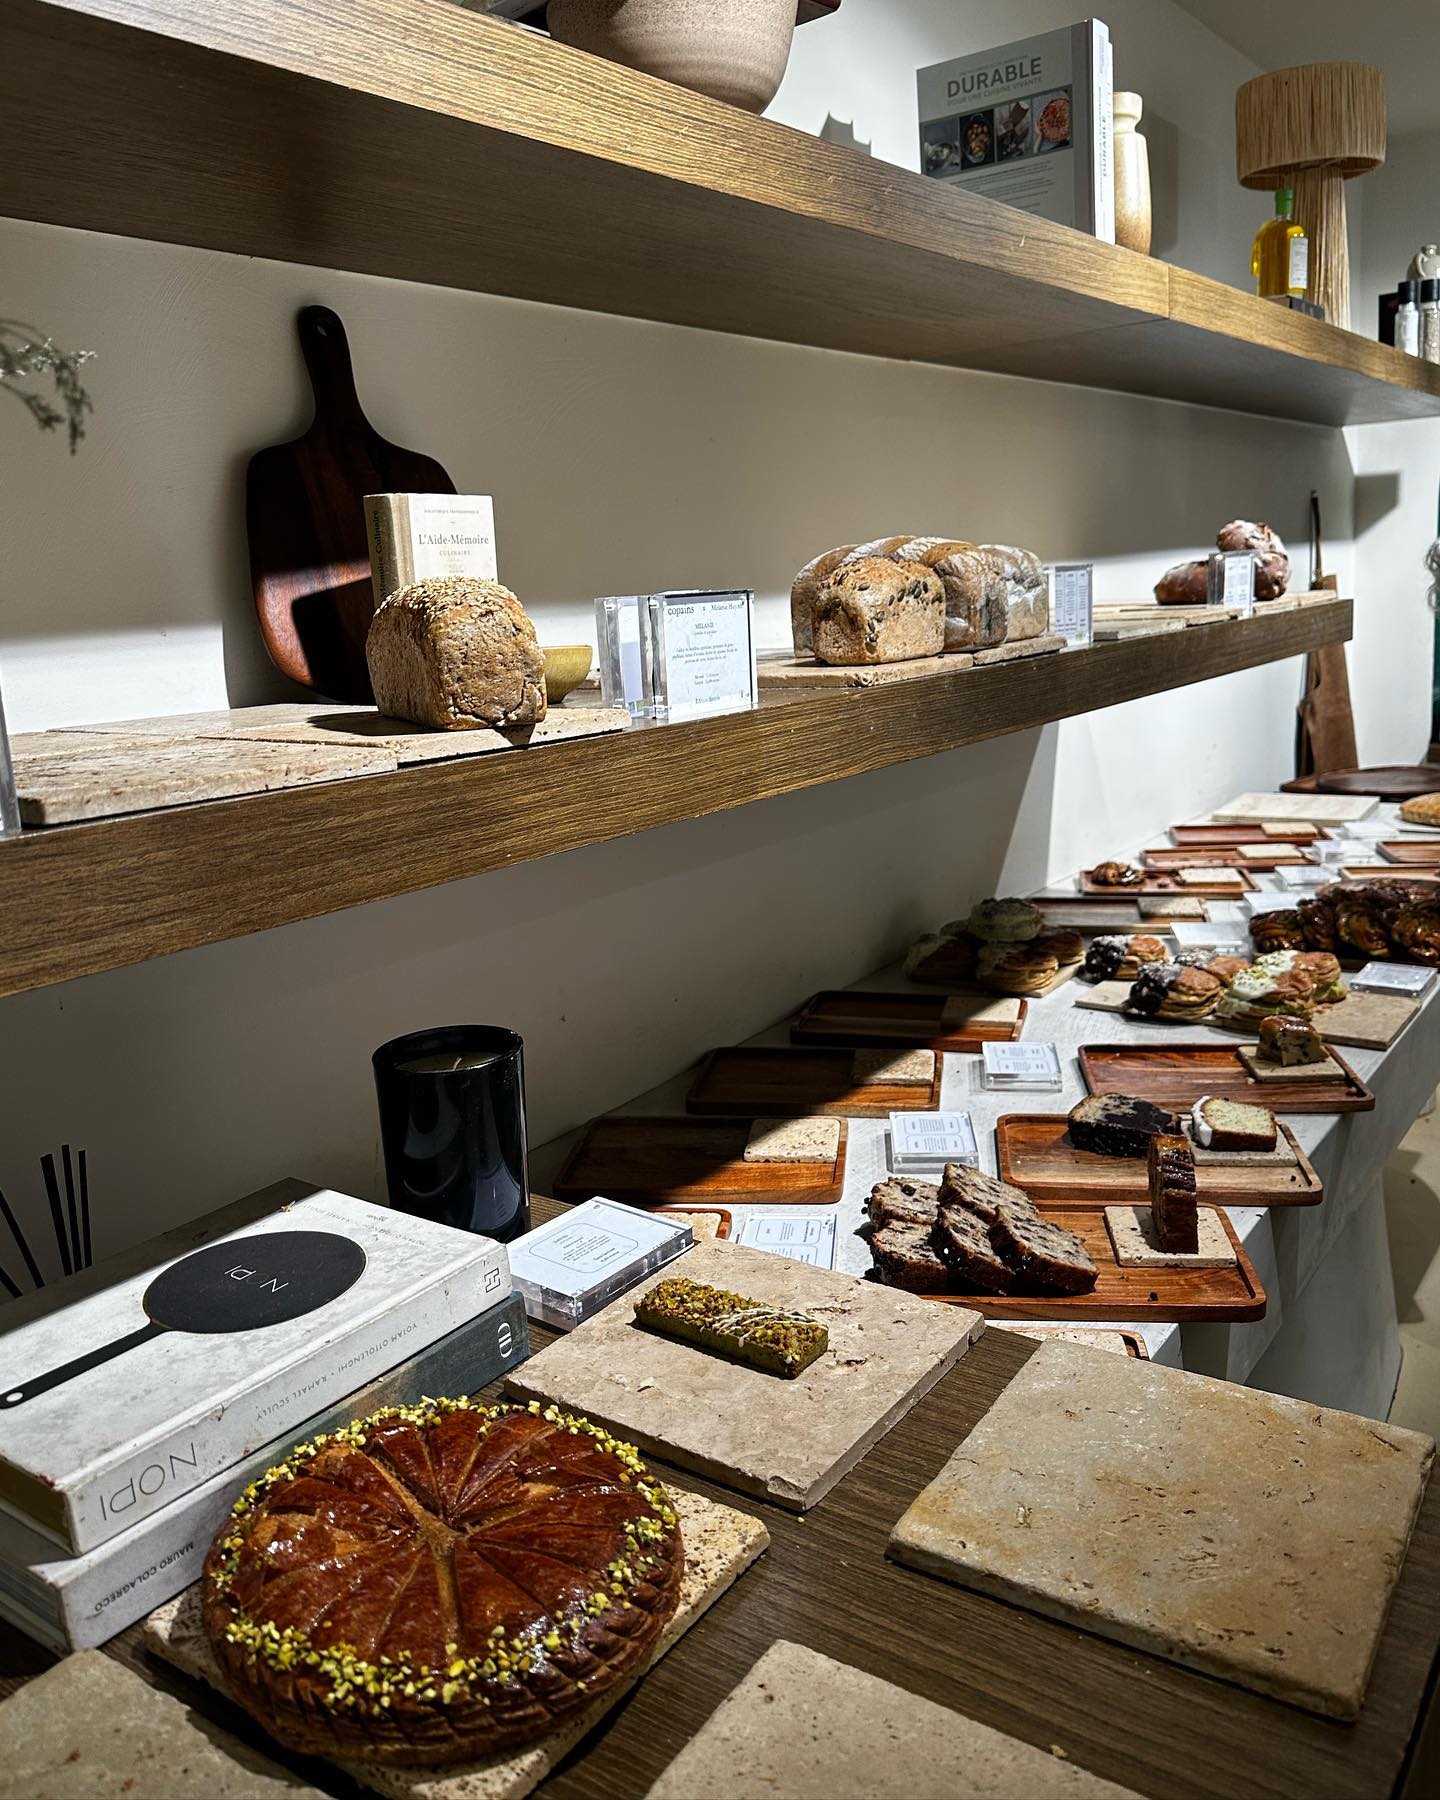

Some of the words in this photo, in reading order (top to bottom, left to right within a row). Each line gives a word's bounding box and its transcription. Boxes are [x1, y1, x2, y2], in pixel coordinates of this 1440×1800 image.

[947, 57, 1042, 98] DURABLE
[418, 533, 489, 545] L'Aide-Mémoire
[667, 606, 695, 617] copains
[391, 1322, 418, 1343] YOTAM
[337, 1340, 389, 1373] OTTOLENGHI
[292, 1376, 327, 1398] RAMAEL
[256, 1397, 290, 1420] SCULLY
[100, 1442, 197, 1520] NOPI
[159, 1541, 194, 1570] MAURO
[94, 1566, 158, 1612] COLAGRECO
